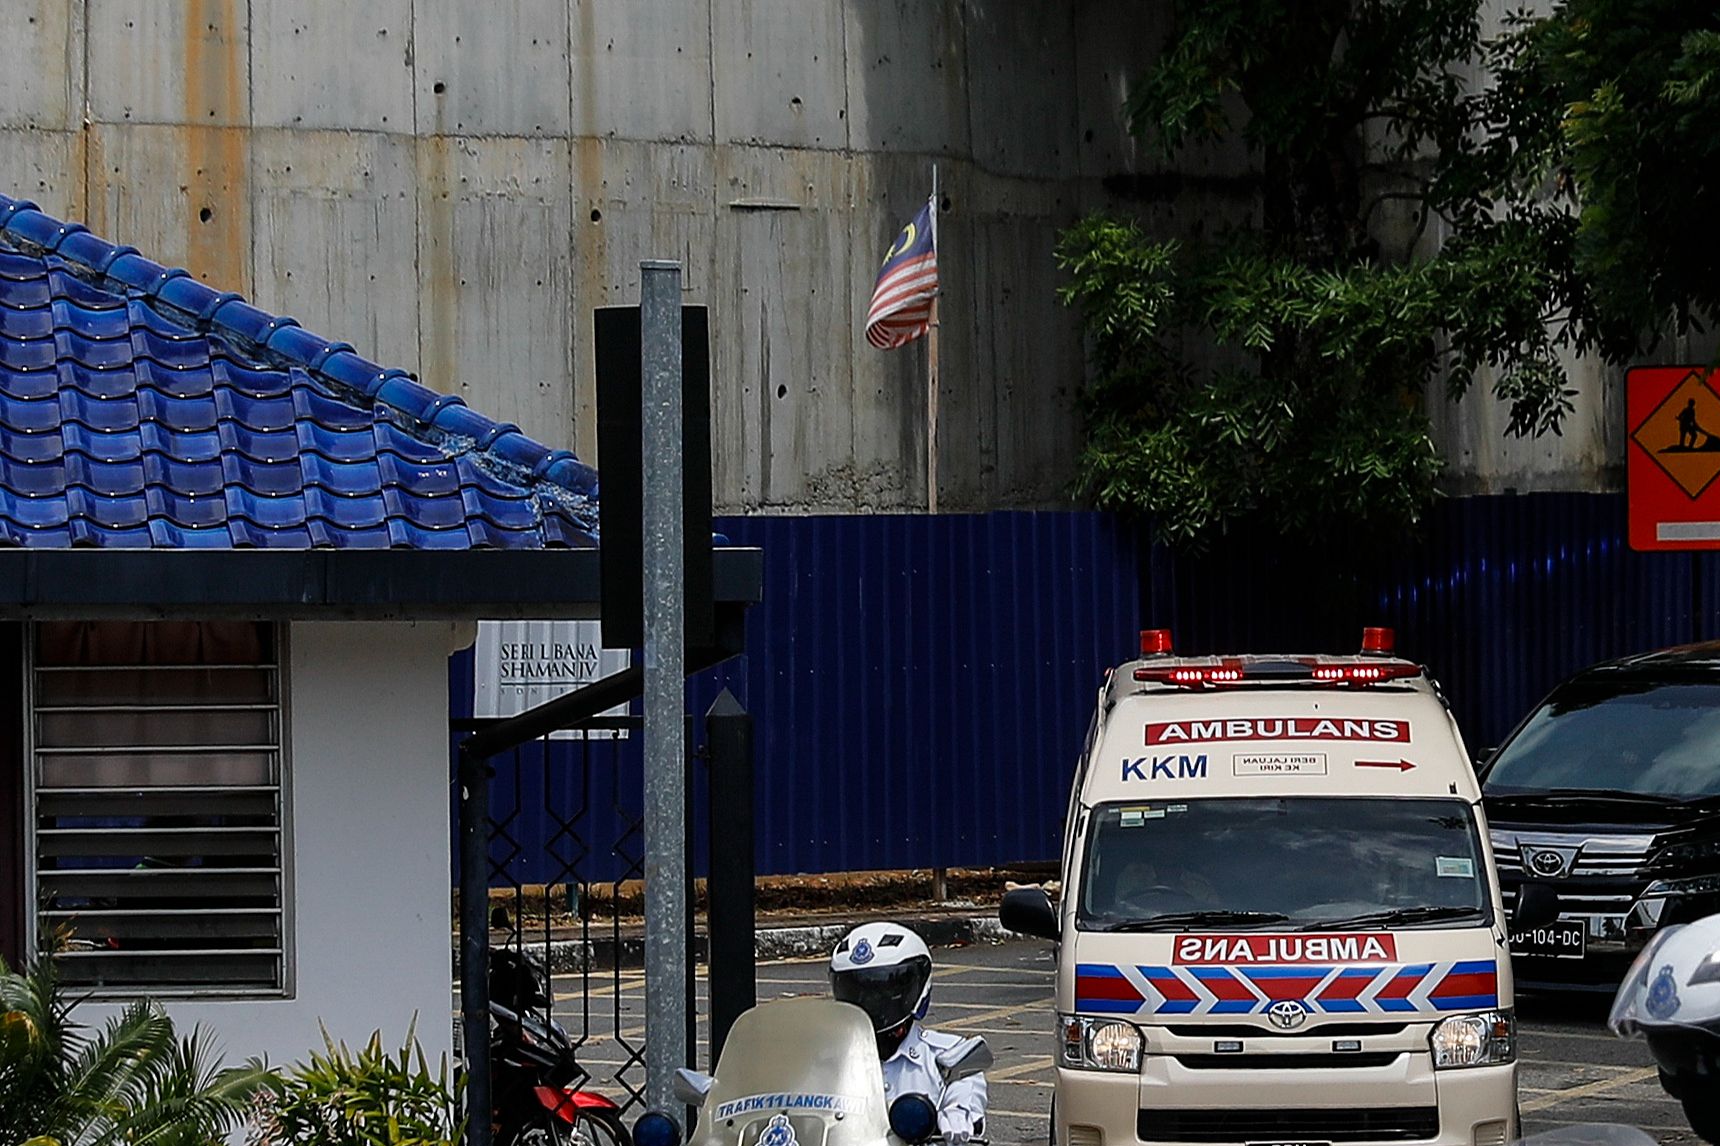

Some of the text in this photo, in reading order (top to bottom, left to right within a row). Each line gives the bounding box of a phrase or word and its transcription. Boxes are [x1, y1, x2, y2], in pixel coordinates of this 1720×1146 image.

[501, 643, 598, 661] SERI LBANA
[1158, 719, 1400, 742] AMBULANS
[1121, 754, 1208, 782] KKM
[718, 1097, 764, 1118] TRAFIK
